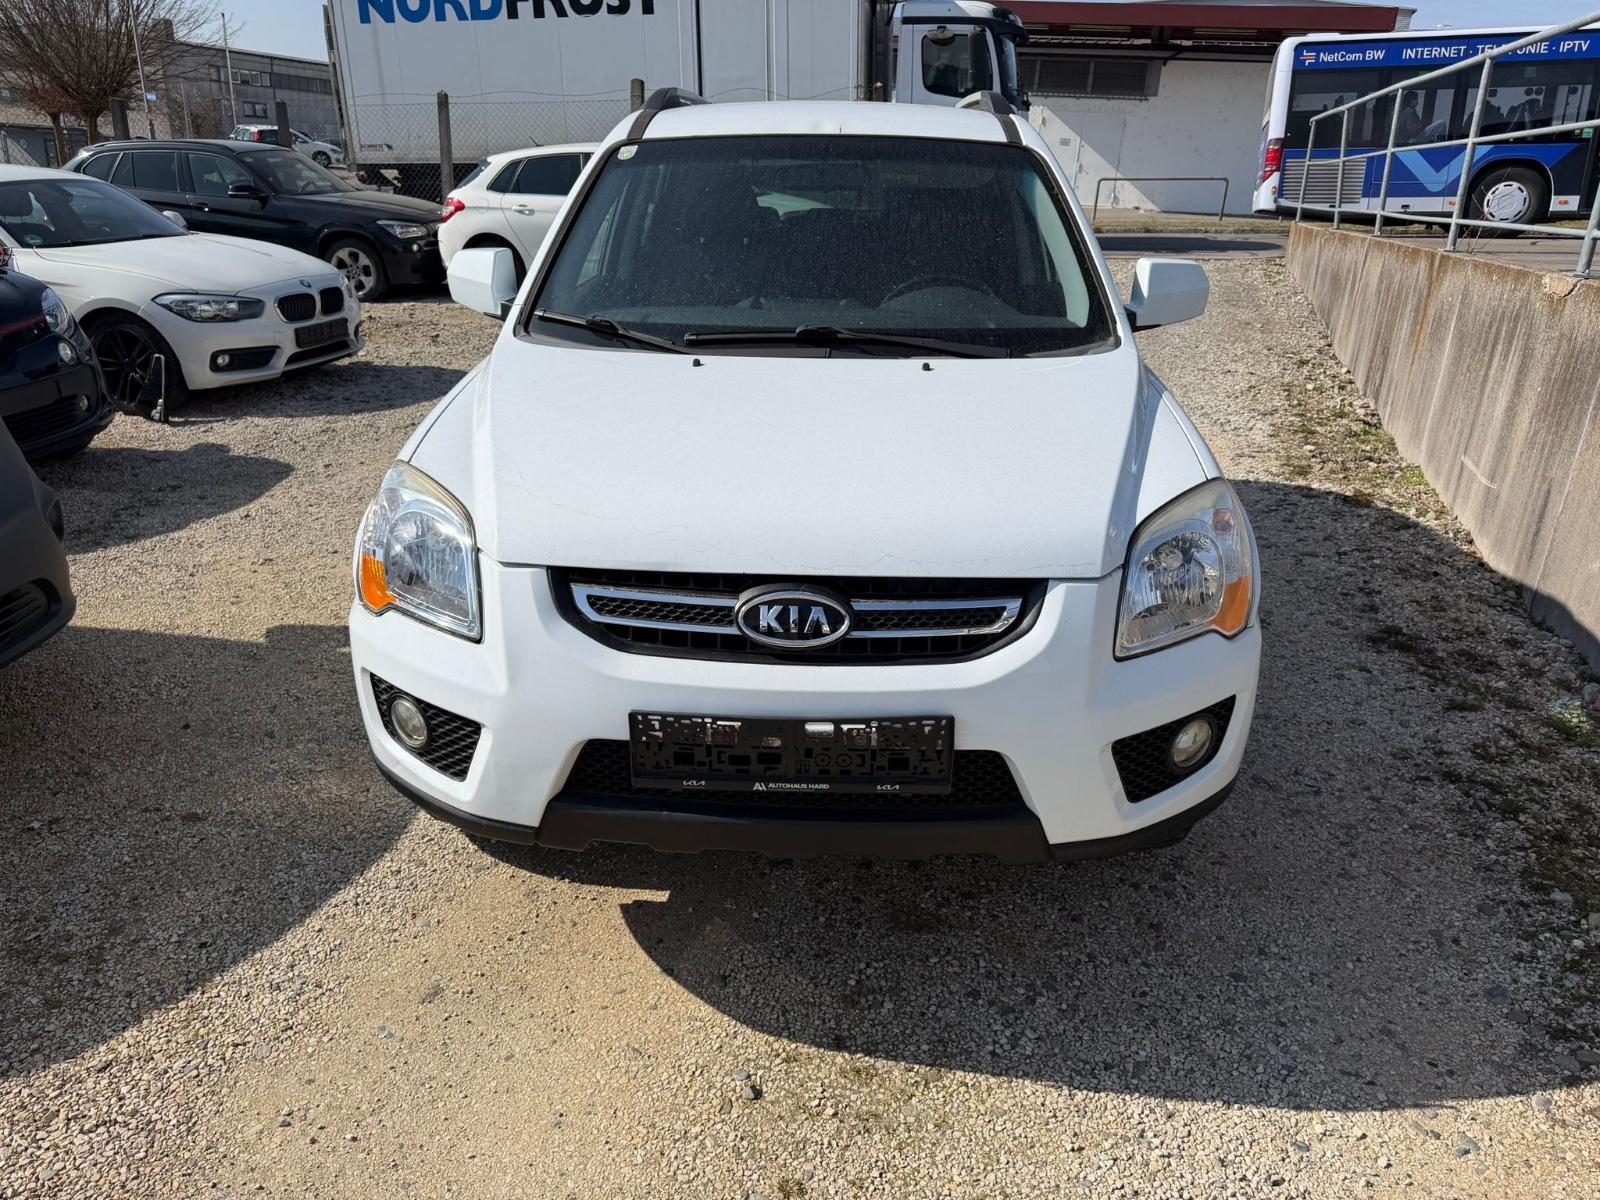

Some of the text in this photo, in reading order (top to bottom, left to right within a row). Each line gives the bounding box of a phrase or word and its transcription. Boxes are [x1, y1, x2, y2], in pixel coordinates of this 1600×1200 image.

[1319, 49, 1386, 62] NetCom BW
[1402, 40, 1591, 60] INTERNET TEONIE IPTV
[759, 605, 830, 634] KIA
